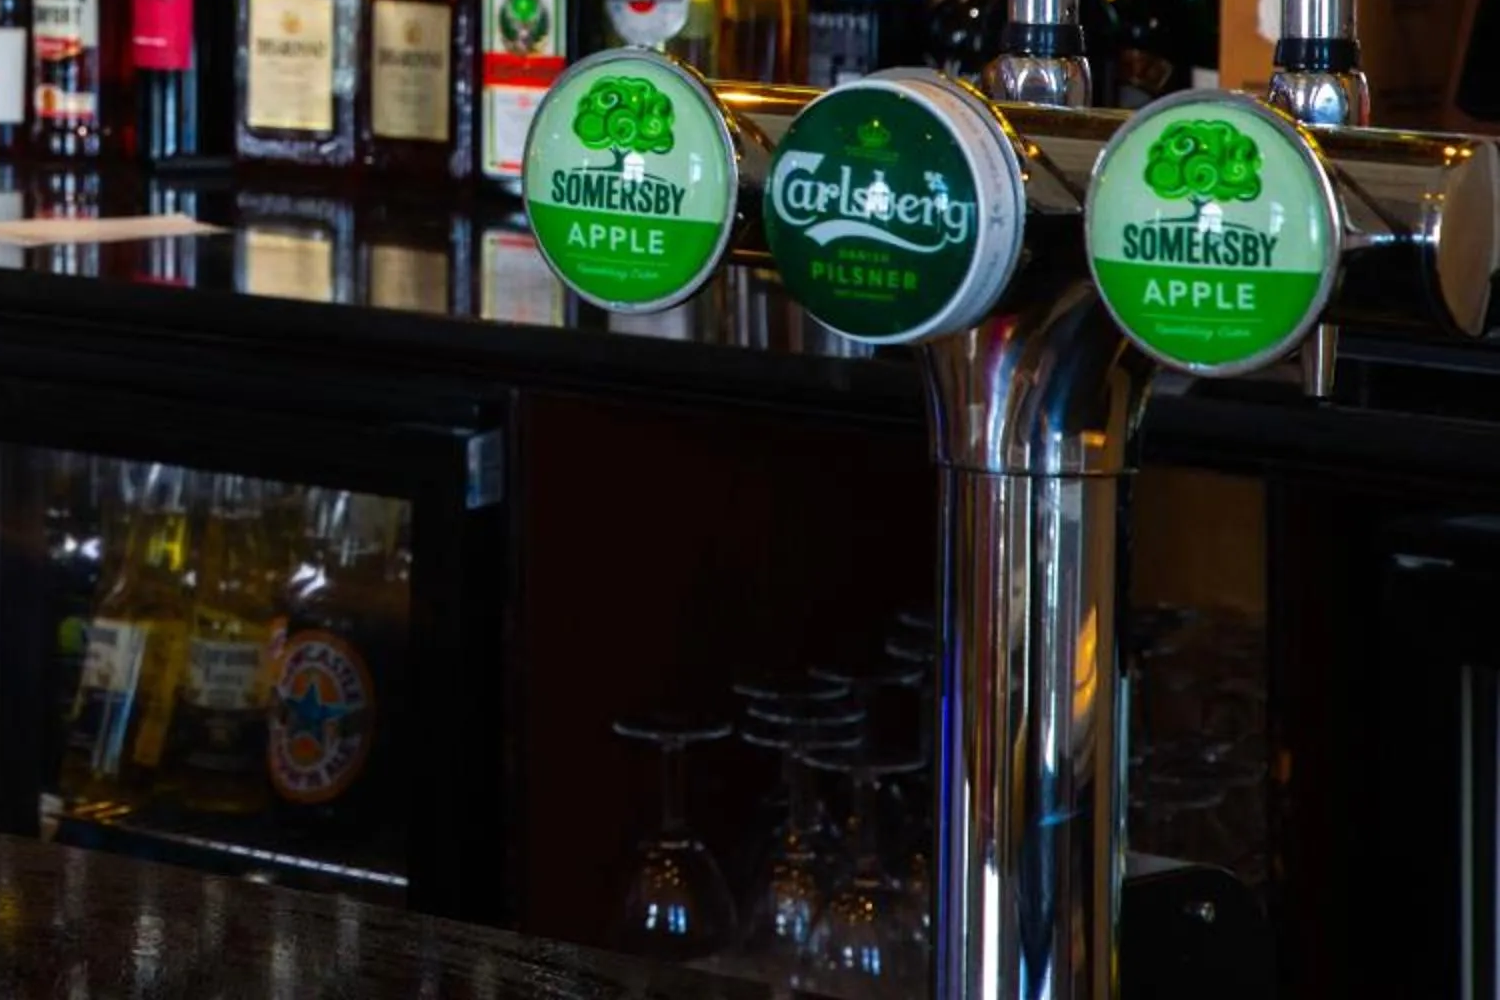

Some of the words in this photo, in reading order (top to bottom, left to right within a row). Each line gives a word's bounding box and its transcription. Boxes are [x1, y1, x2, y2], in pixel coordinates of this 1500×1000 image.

[551, 169, 687, 217] SOMERSBY
[772, 149, 974, 247] Carlsberg
[567, 221, 665, 255] APPLE
[1123, 223, 1277, 268] SOMERSBY
[811, 259, 918, 291] PILSNER
[1143, 278, 1256, 311] APPLE
